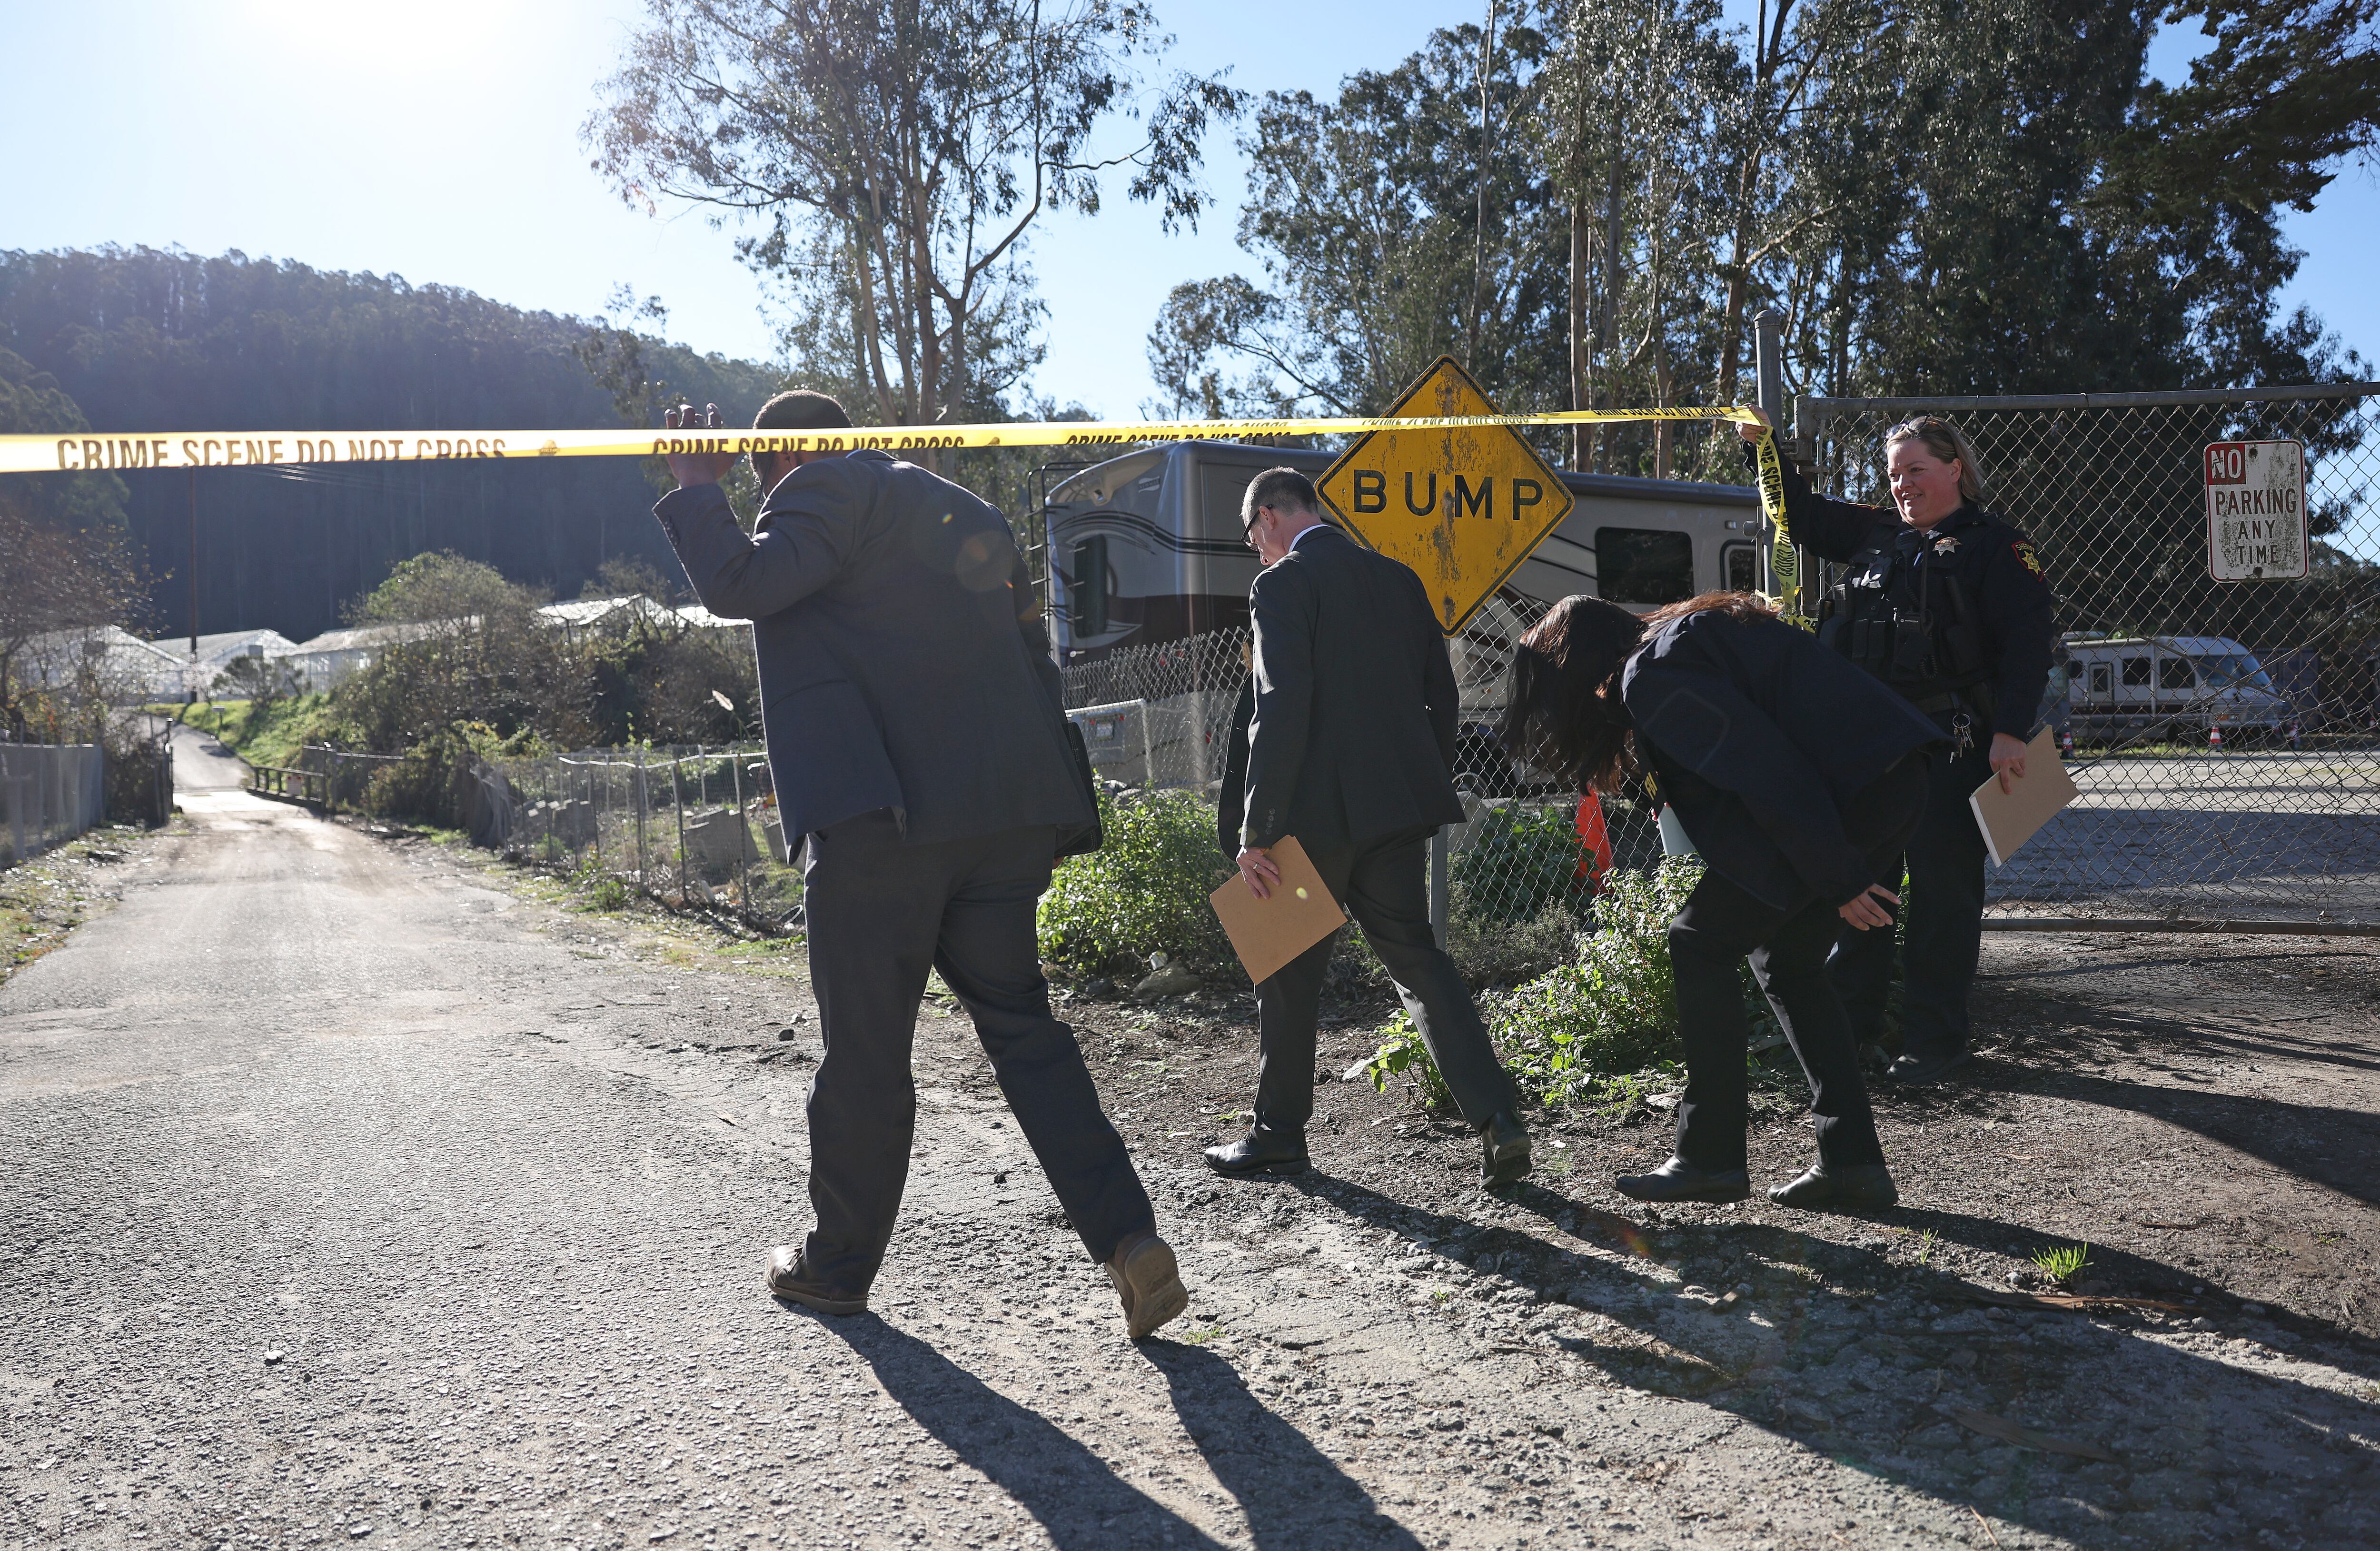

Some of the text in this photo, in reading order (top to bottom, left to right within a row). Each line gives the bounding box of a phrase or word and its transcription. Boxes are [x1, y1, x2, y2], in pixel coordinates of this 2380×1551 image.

[57, 439, 168, 470] CRIME
[182, 439, 283, 467] SCENE
[297, 439, 336, 463] DO
[348, 439, 403, 461] NOT
[2211, 449, 2242, 478] NO
[1354, 469, 1543, 520] BUMP
[2215, 488, 2297, 515] PARKING
[2238, 520, 2275, 539] ANY
[2238, 545, 2278, 564] TIME
[1645, 772, 1657, 800] FBI
